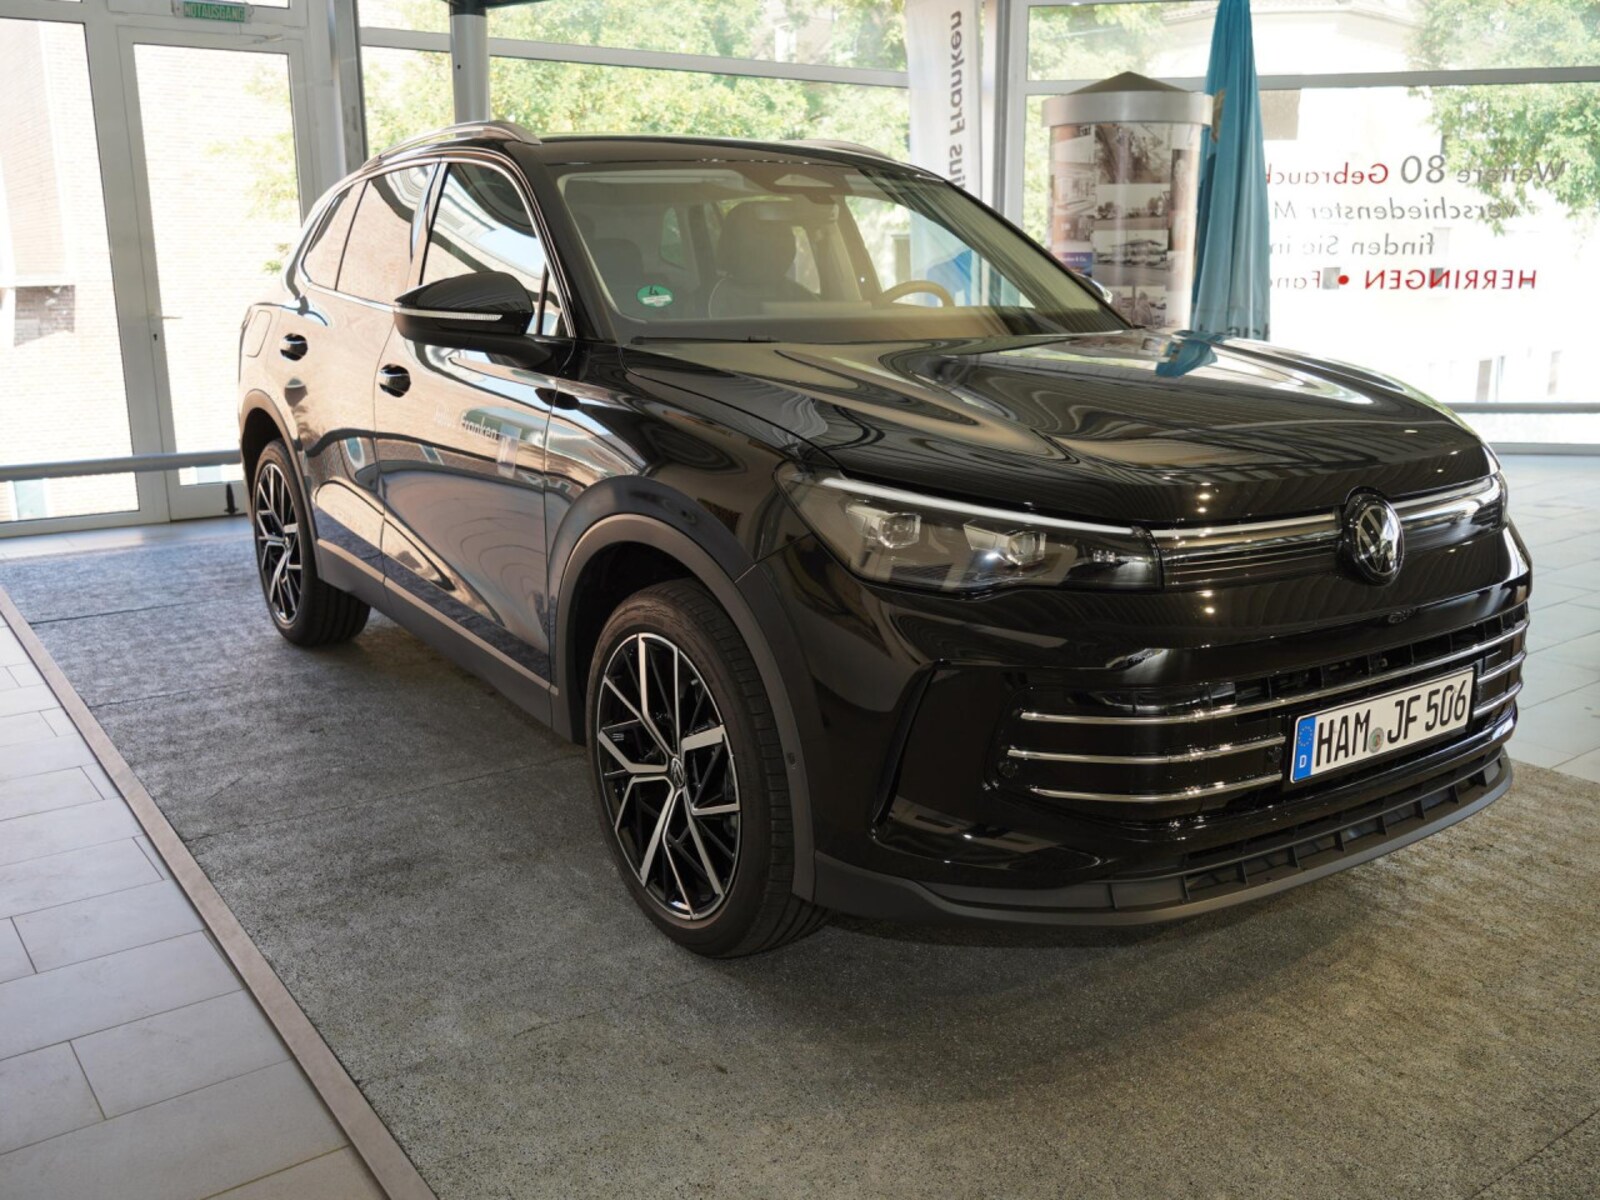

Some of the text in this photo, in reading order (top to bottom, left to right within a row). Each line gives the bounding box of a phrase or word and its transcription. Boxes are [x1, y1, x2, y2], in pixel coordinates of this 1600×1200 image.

[183, 3, 245, 21] NOTAUSGANG
[1315, 708, 1371, 768] HAM
[1387, 694, 1421, 745] JF
[1424, 679, 1467, 732] 506
